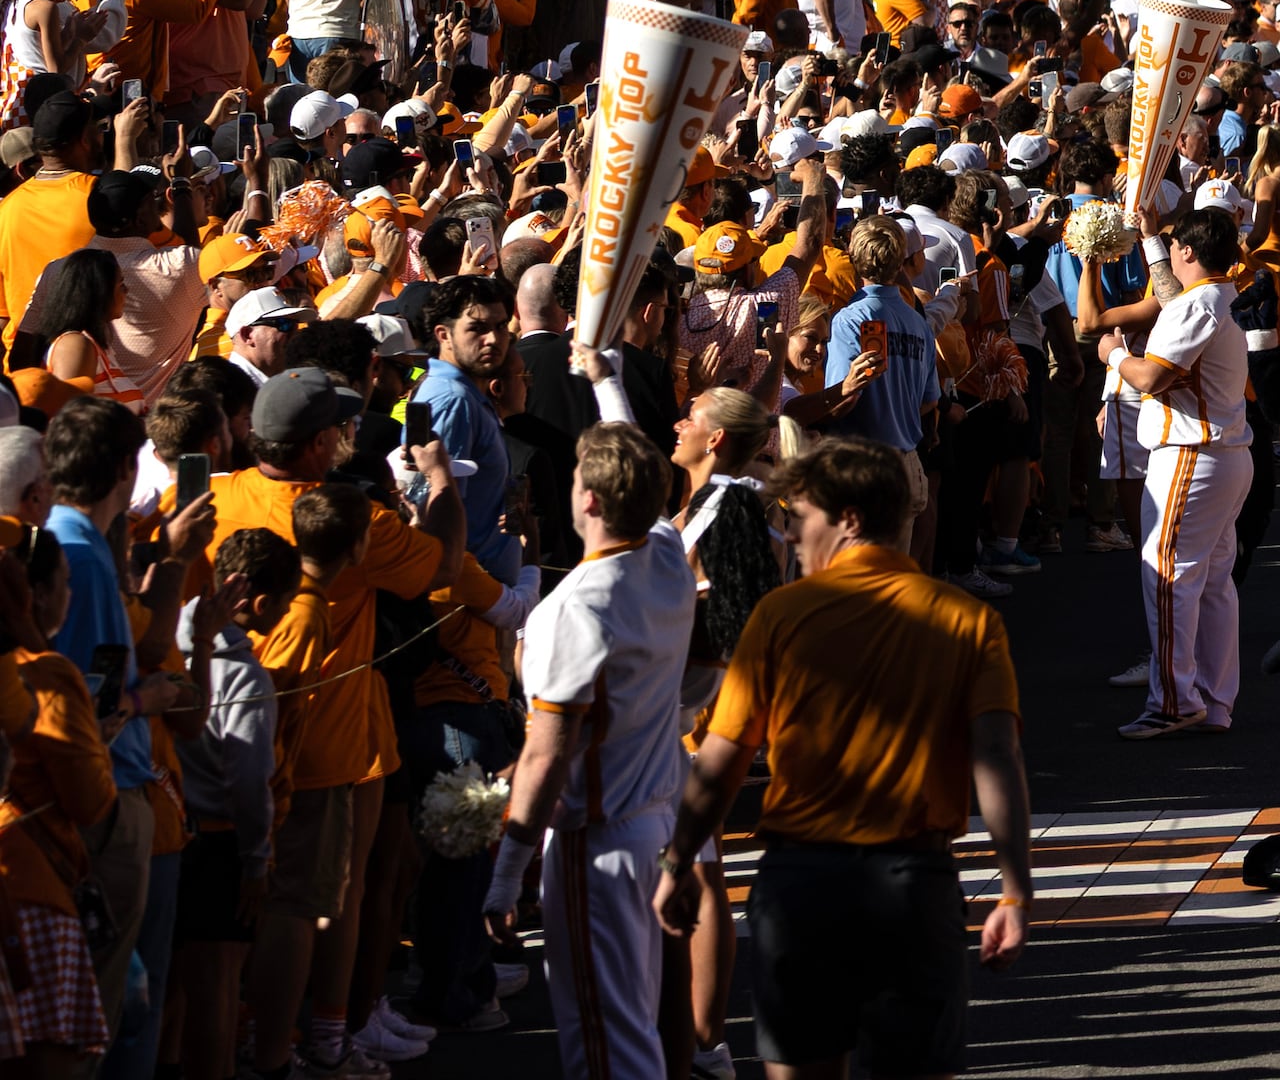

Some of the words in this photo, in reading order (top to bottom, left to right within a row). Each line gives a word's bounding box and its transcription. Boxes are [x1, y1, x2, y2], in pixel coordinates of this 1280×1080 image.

[1137, 24, 1154, 71] TOP
[1176, 28, 1210, 63] T
[1130, 76, 1149, 160] ROCKY
[589, 132, 635, 265] ROCKY
[613, 51, 648, 122] TOP
[1209, 187, 1221, 198] T
[235, 235, 252, 251] T
